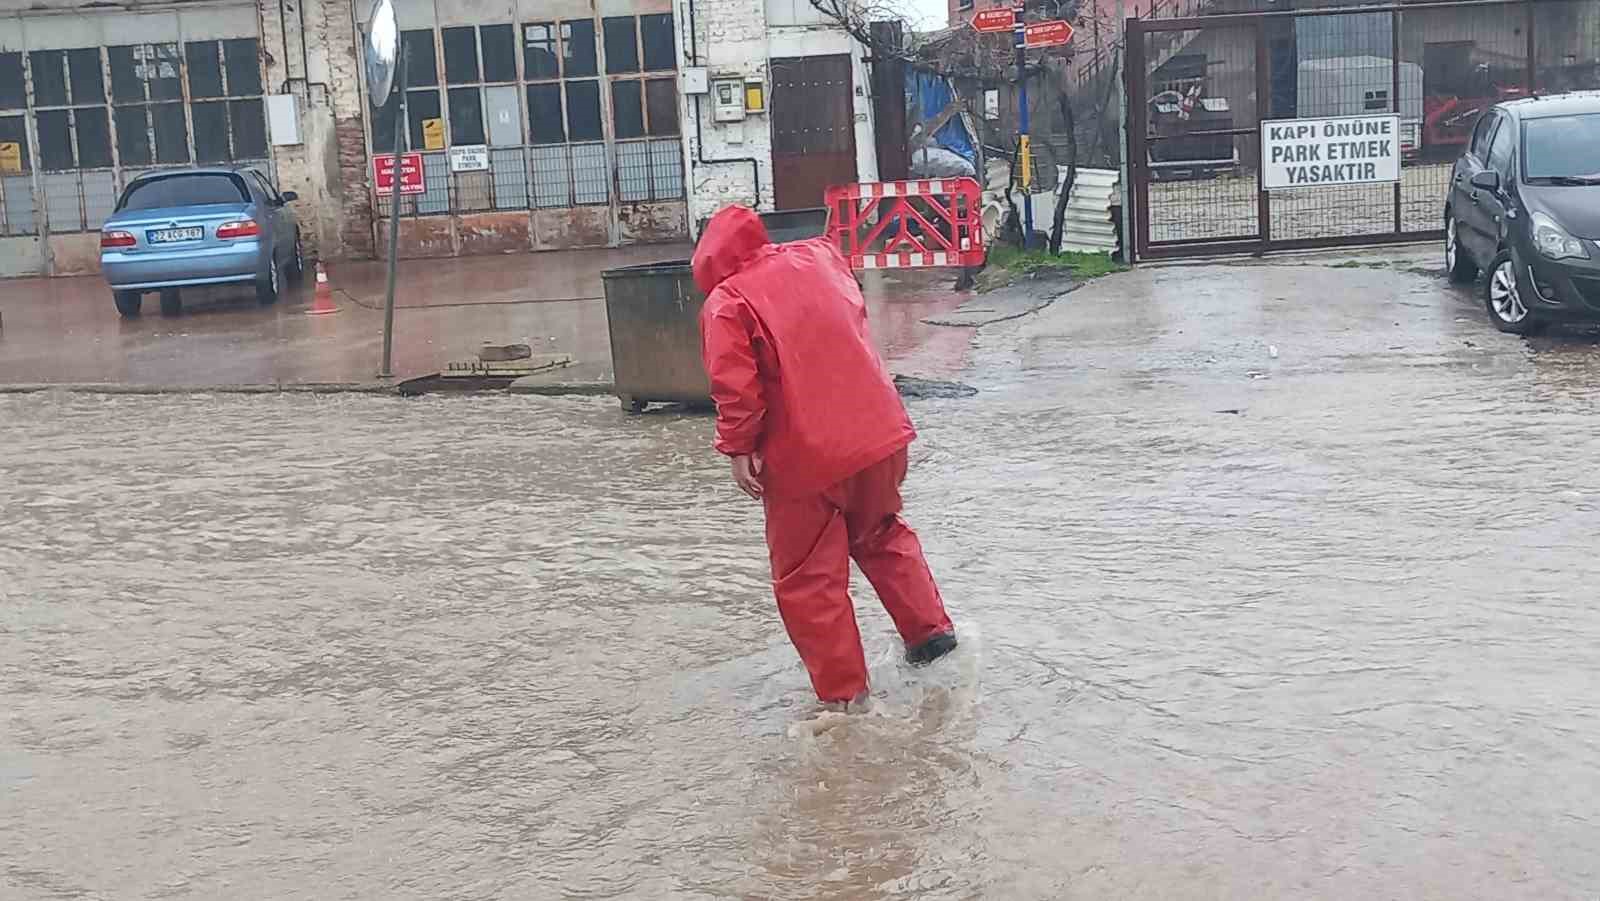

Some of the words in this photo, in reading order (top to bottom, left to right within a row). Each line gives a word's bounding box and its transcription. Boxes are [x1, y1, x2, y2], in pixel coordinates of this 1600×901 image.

[1270, 125, 1315, 141] KAPI
[1323, 120, 1391, 138] ÖNÜNE
[1271, 144, 1321, 163] PARK
[1327, 140, 1391, 161] ETMEK
[1286, 162, 1376, 183] YASAKTIR
